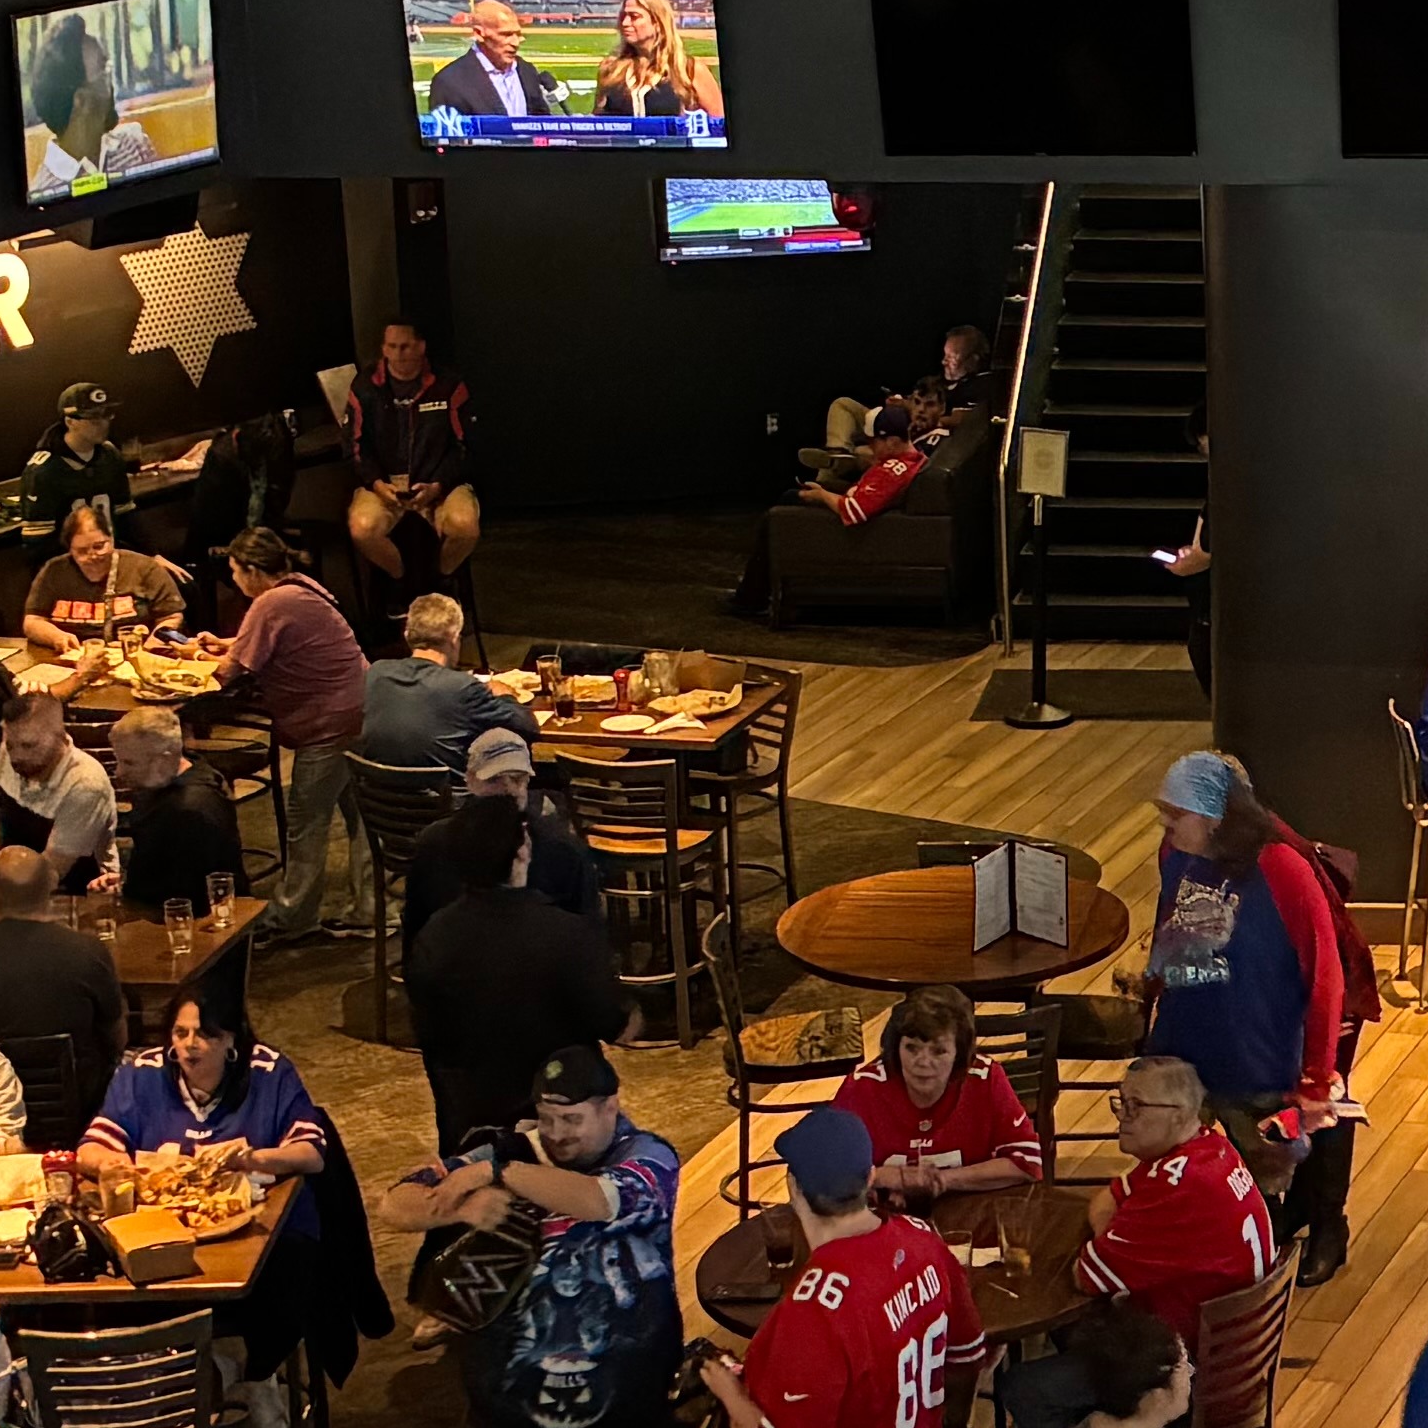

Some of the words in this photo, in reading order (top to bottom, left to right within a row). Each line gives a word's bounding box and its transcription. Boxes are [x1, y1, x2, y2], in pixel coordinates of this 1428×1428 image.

[882, 458, 908, 477] 58
[791, 1266, 851, 1311] 86
[883, 1263, 942, 1333] KINCAID
